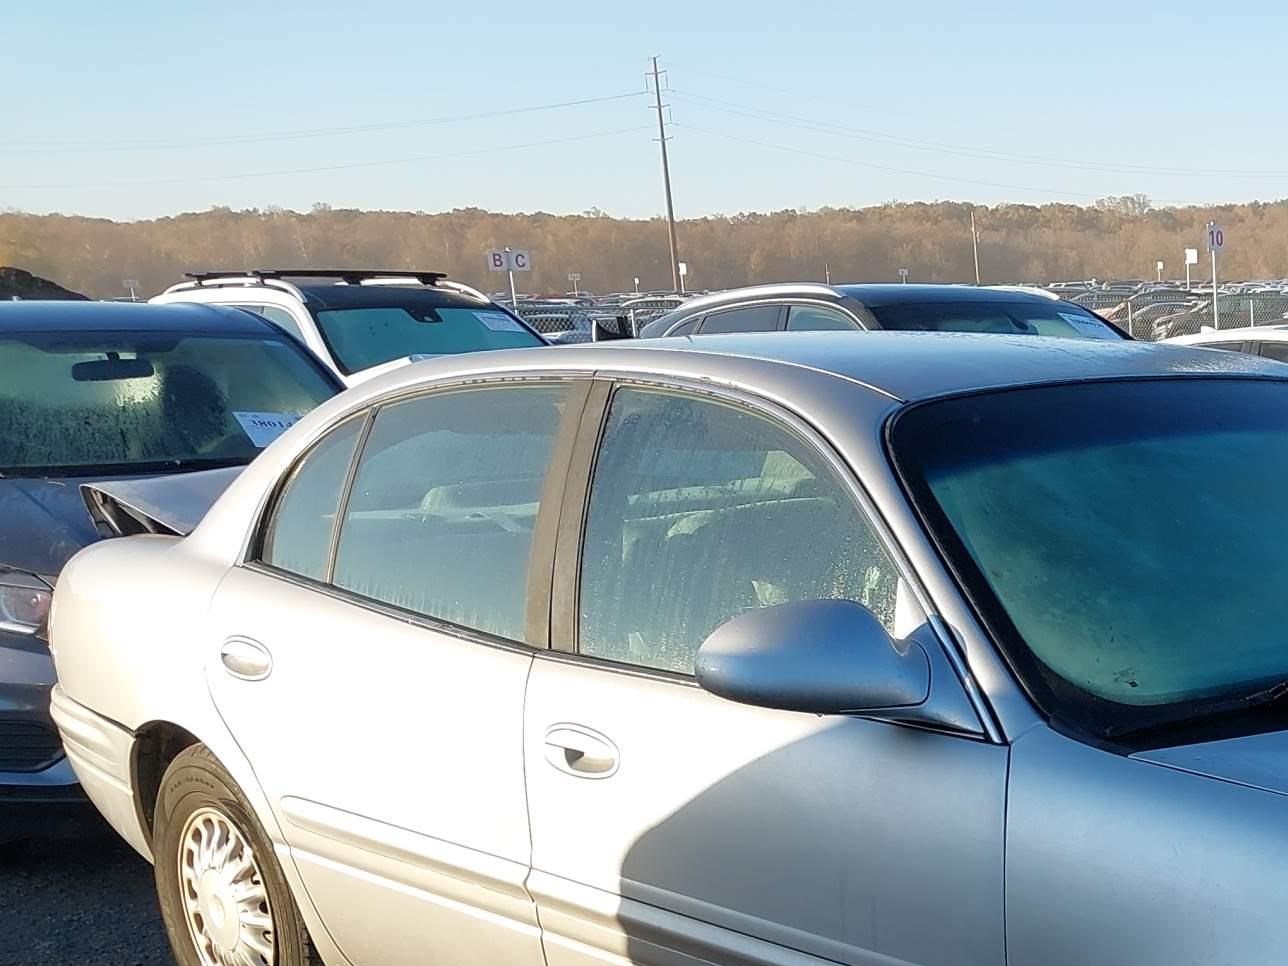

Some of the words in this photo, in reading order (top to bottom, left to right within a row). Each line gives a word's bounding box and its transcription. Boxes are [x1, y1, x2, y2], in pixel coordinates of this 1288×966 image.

[1208, 230, 1223, 246] 10
[492, 253, 504, 267] B
[515, 254, 526, 267] C
